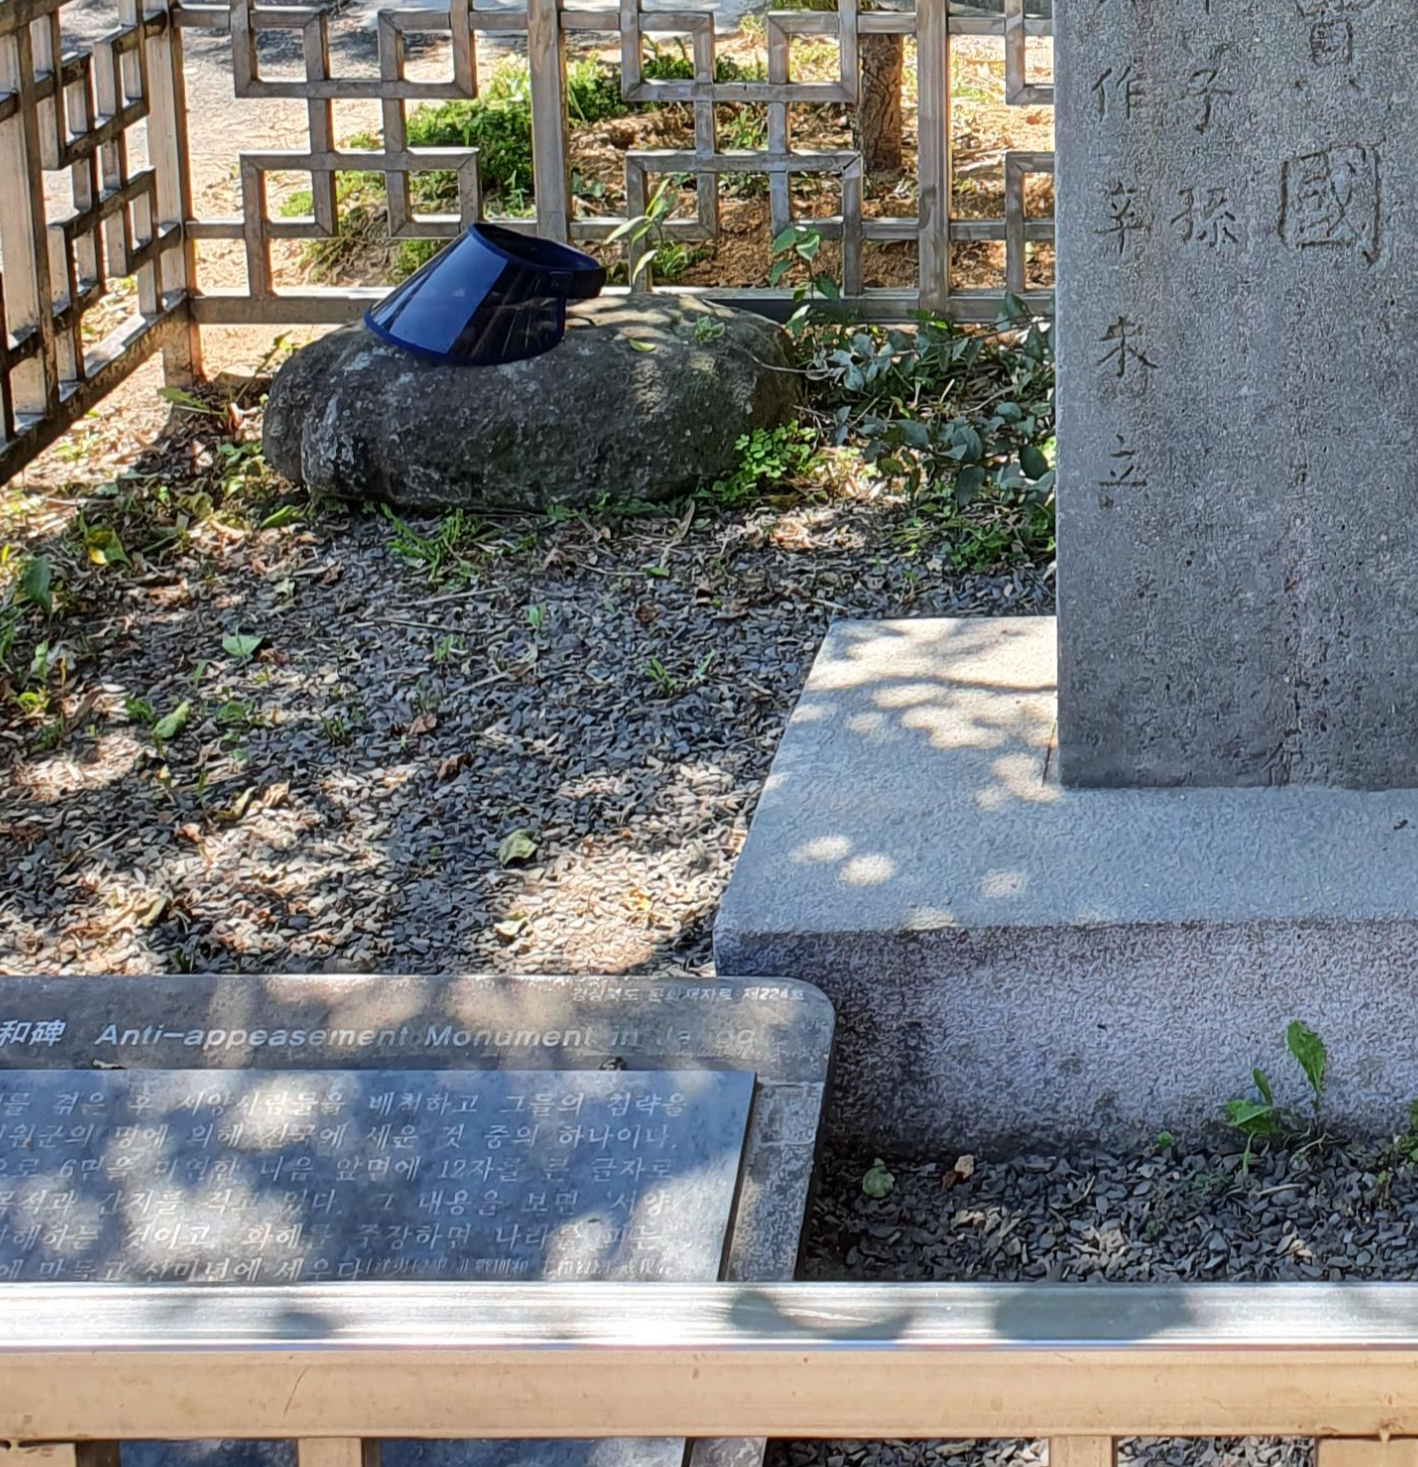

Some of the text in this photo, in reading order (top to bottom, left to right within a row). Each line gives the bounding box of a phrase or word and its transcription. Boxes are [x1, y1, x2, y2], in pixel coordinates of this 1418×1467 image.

[94, 1022, 408, 1051] Anti-appeasement
[423, 1024, 597, 1047] Monument
[0, 1091, 30, 1117] 를
[499, 1091, 586, 1117] 그들의
[606, 1091, 689, 1117] 침략을
[367, 1123, 420, 1150] 세운
[484, 1123, 541, 1150] 중의
[0, 1223, 98, 1250] 해하는
